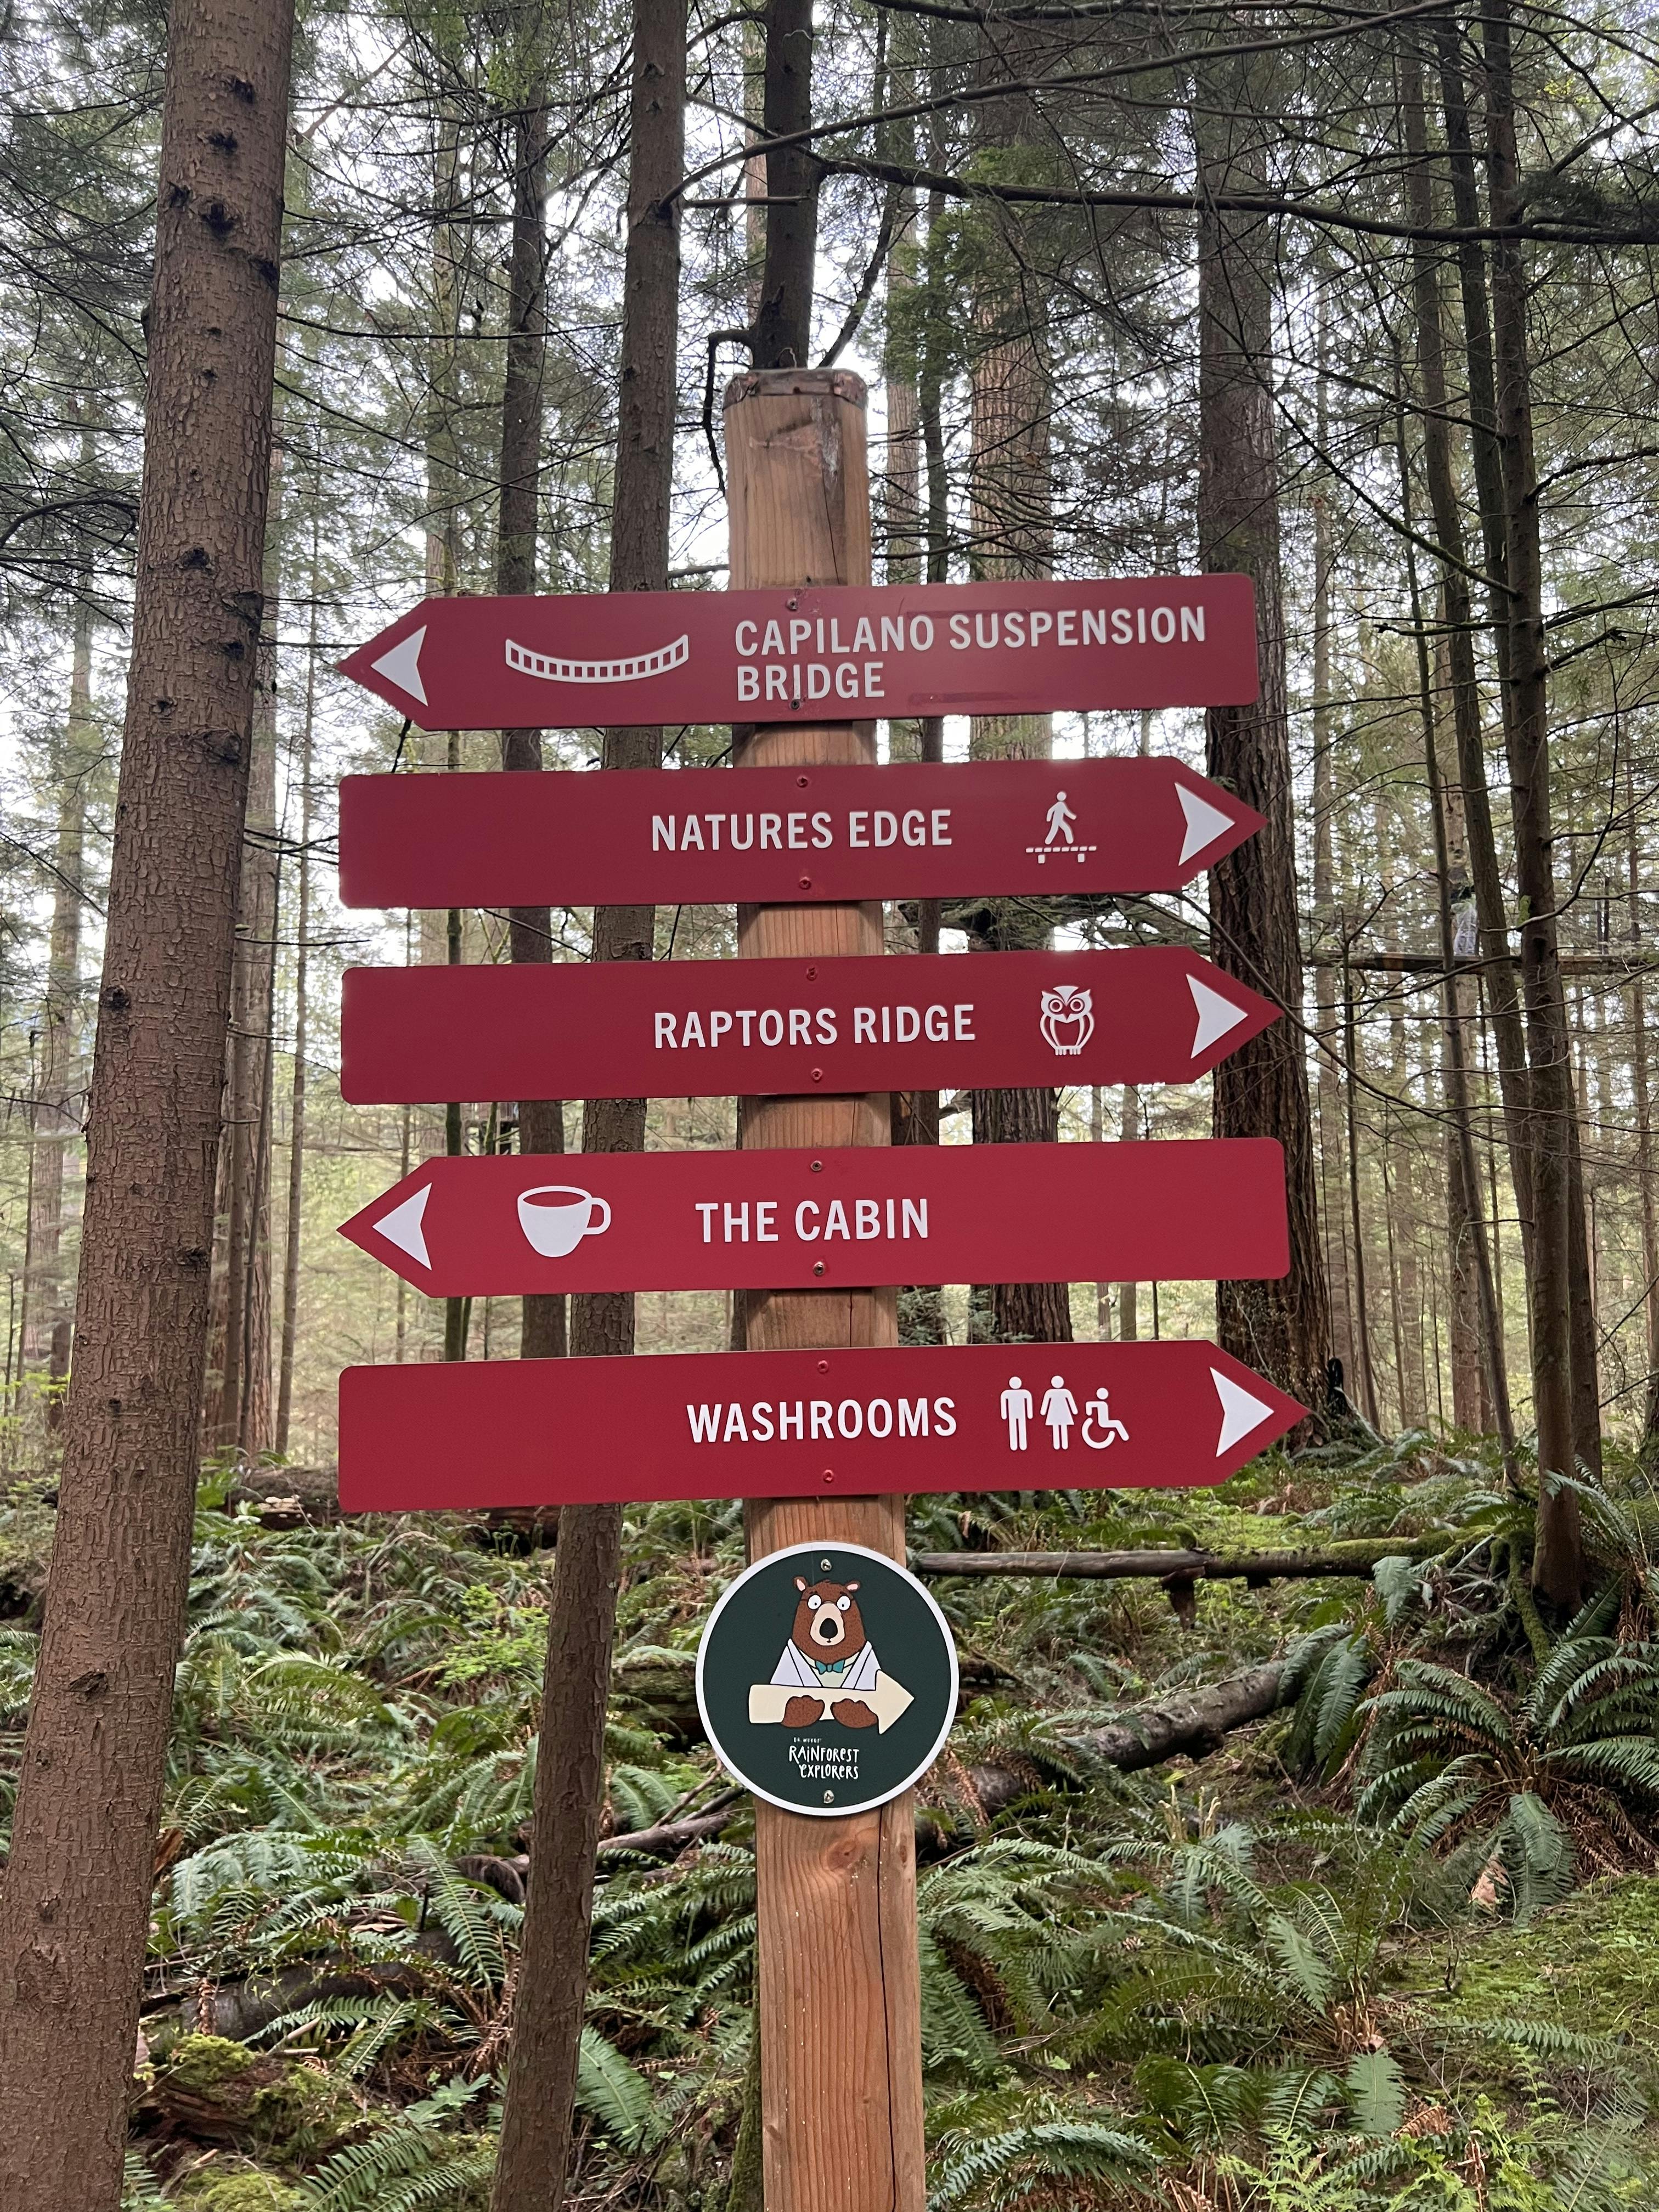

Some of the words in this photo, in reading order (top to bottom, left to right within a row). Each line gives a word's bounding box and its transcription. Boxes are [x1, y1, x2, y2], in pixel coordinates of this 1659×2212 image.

[735, 615, 934, 656] CAPILANO
[949, 606, 1205, 650] SUSPENSION
[737, 662, 885, 701] BRIDGE
[652, 812, 833, 851] NATURES
[849, 809, 952, 848] EDGE
[654, 1008, 837, 1048] RAPTORS
[854, 1004, 975, 1043] RIDGE
[695, 1201, 778, 1243] THE
[795, 1198, 930, 1241] CABIN
[686, 1397, 957, 1443] WASHROOMS
